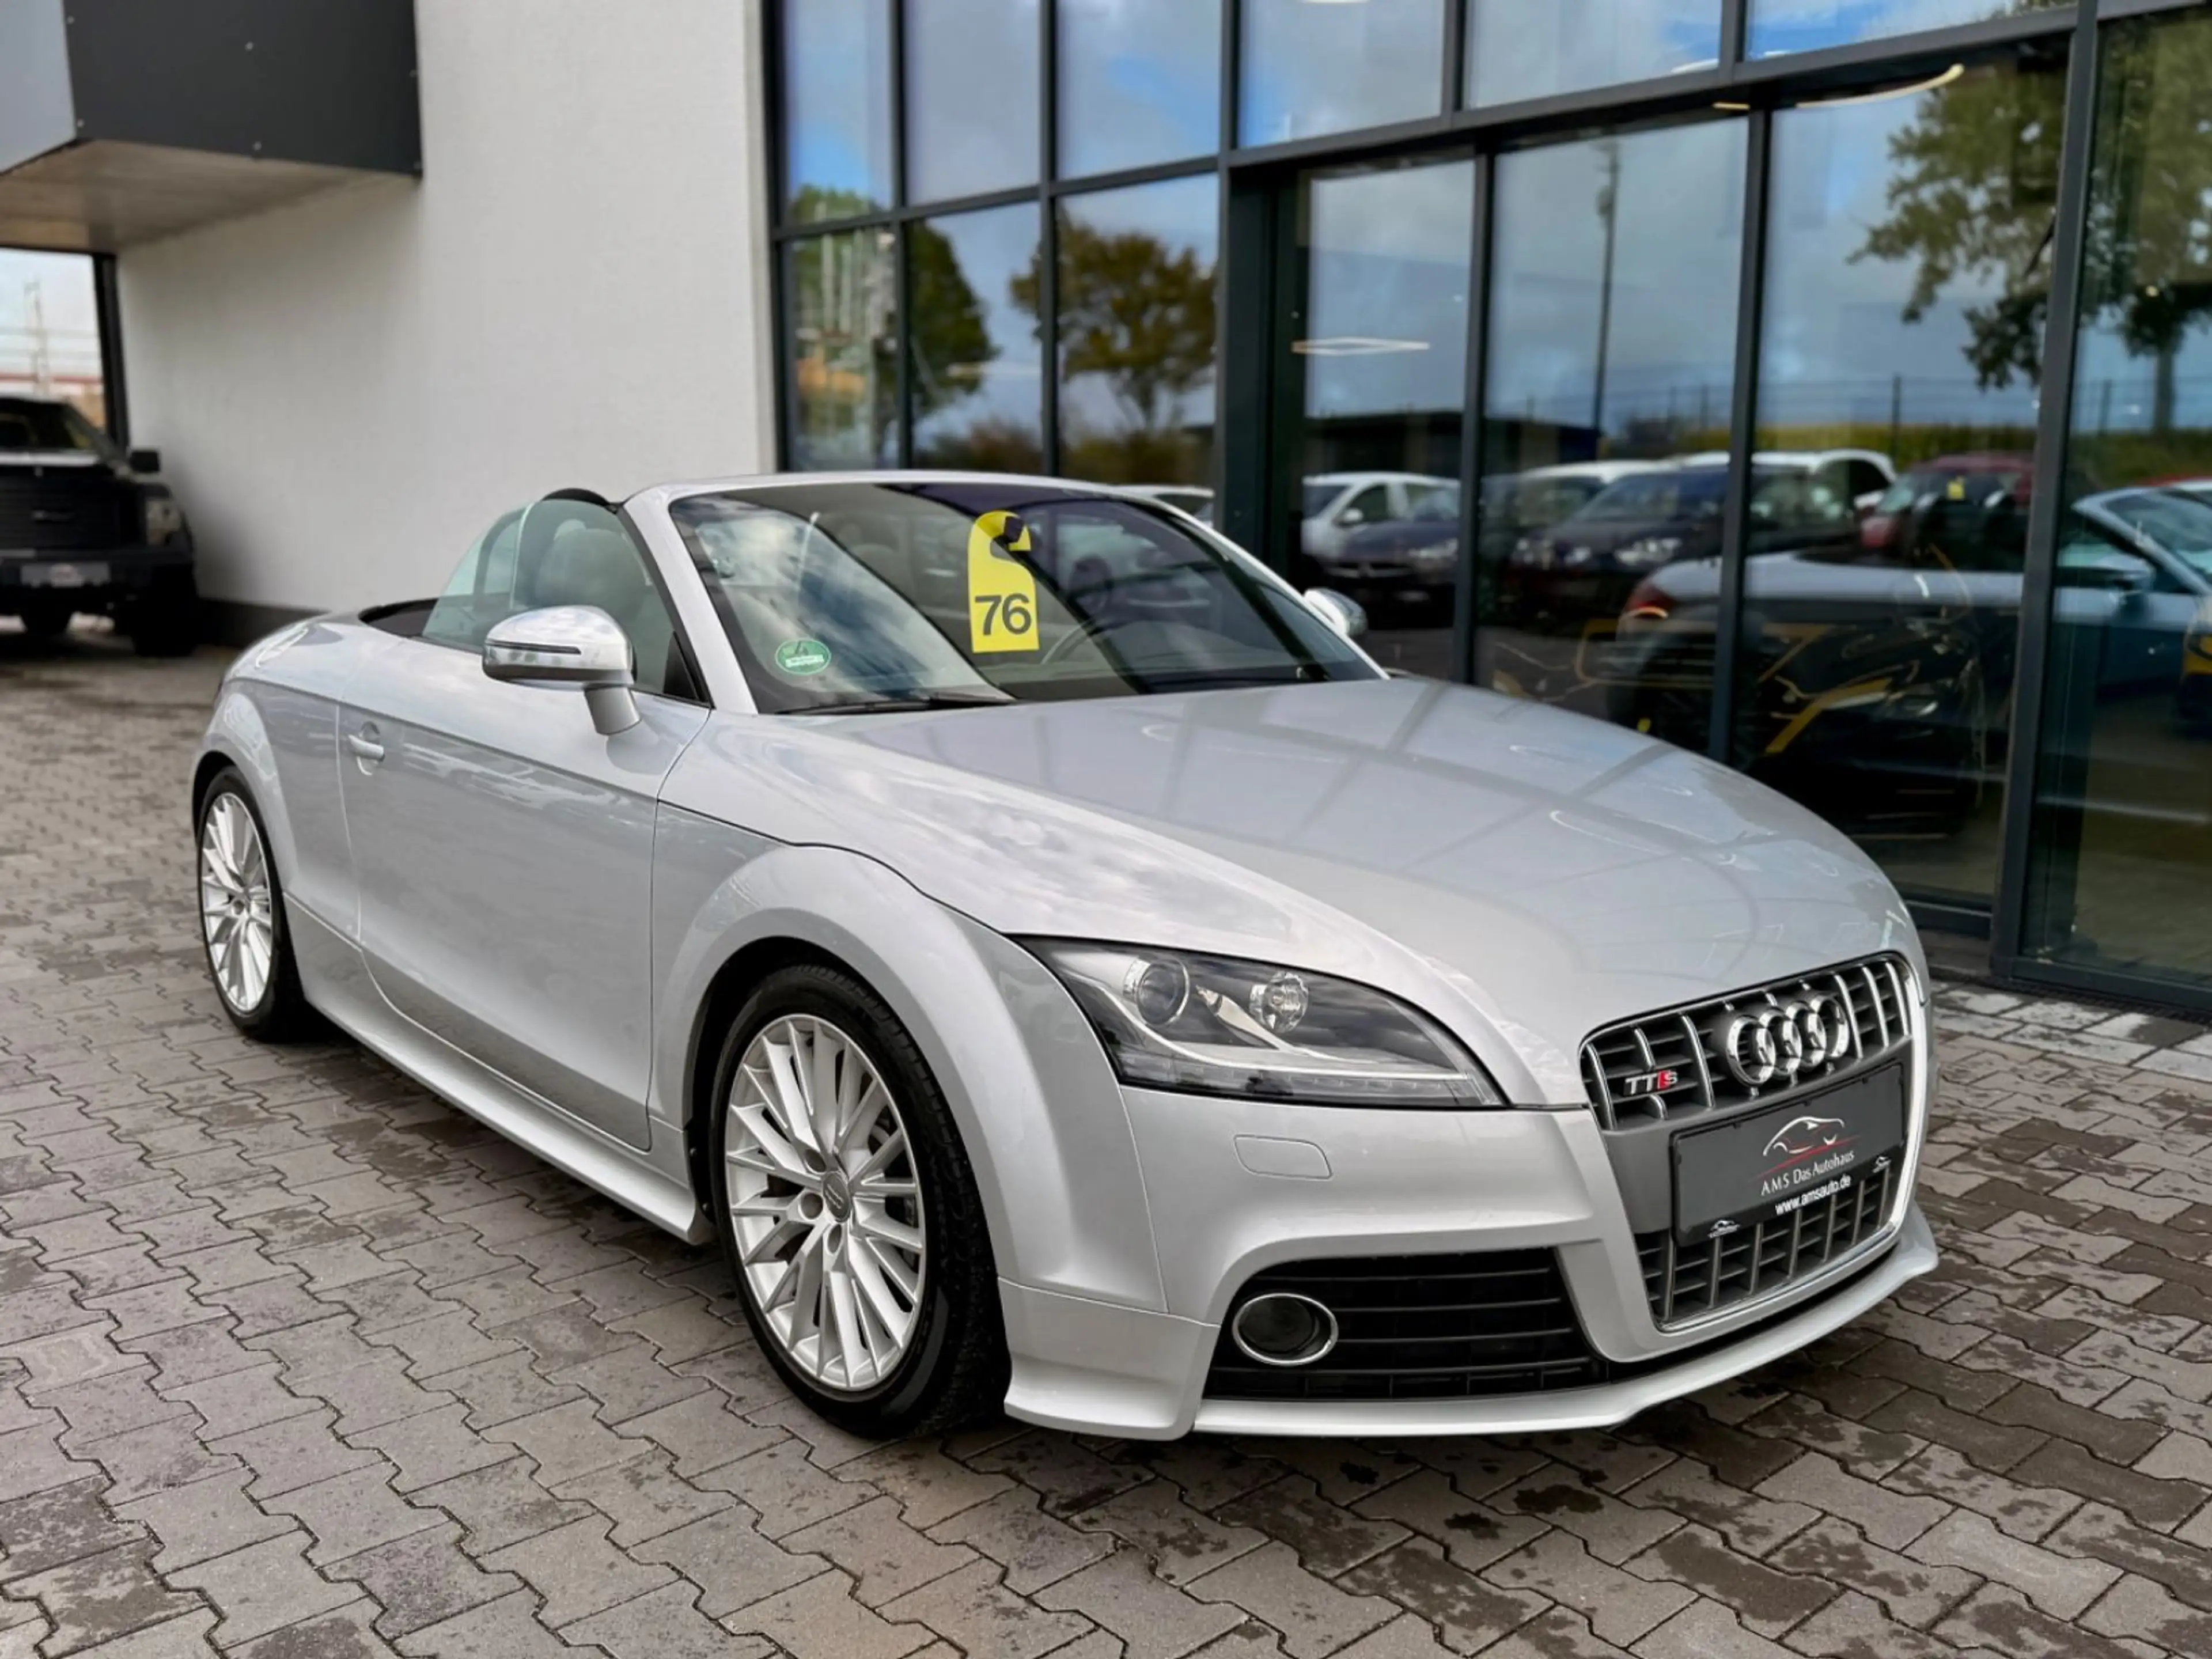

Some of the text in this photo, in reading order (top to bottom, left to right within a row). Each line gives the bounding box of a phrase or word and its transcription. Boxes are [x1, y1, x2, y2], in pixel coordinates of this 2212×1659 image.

[975, 593, 1031, 636] 76
[1625, 1070, 1678, 1094] TTS
[1761, 1172, 1789, 1196] AMS
[1793, 1168, 1812, 1184] Das
[1813, 1150, 1855, 1176] Autohaus
[1775, 1174, 1851, 1215] www.amsauto.de
